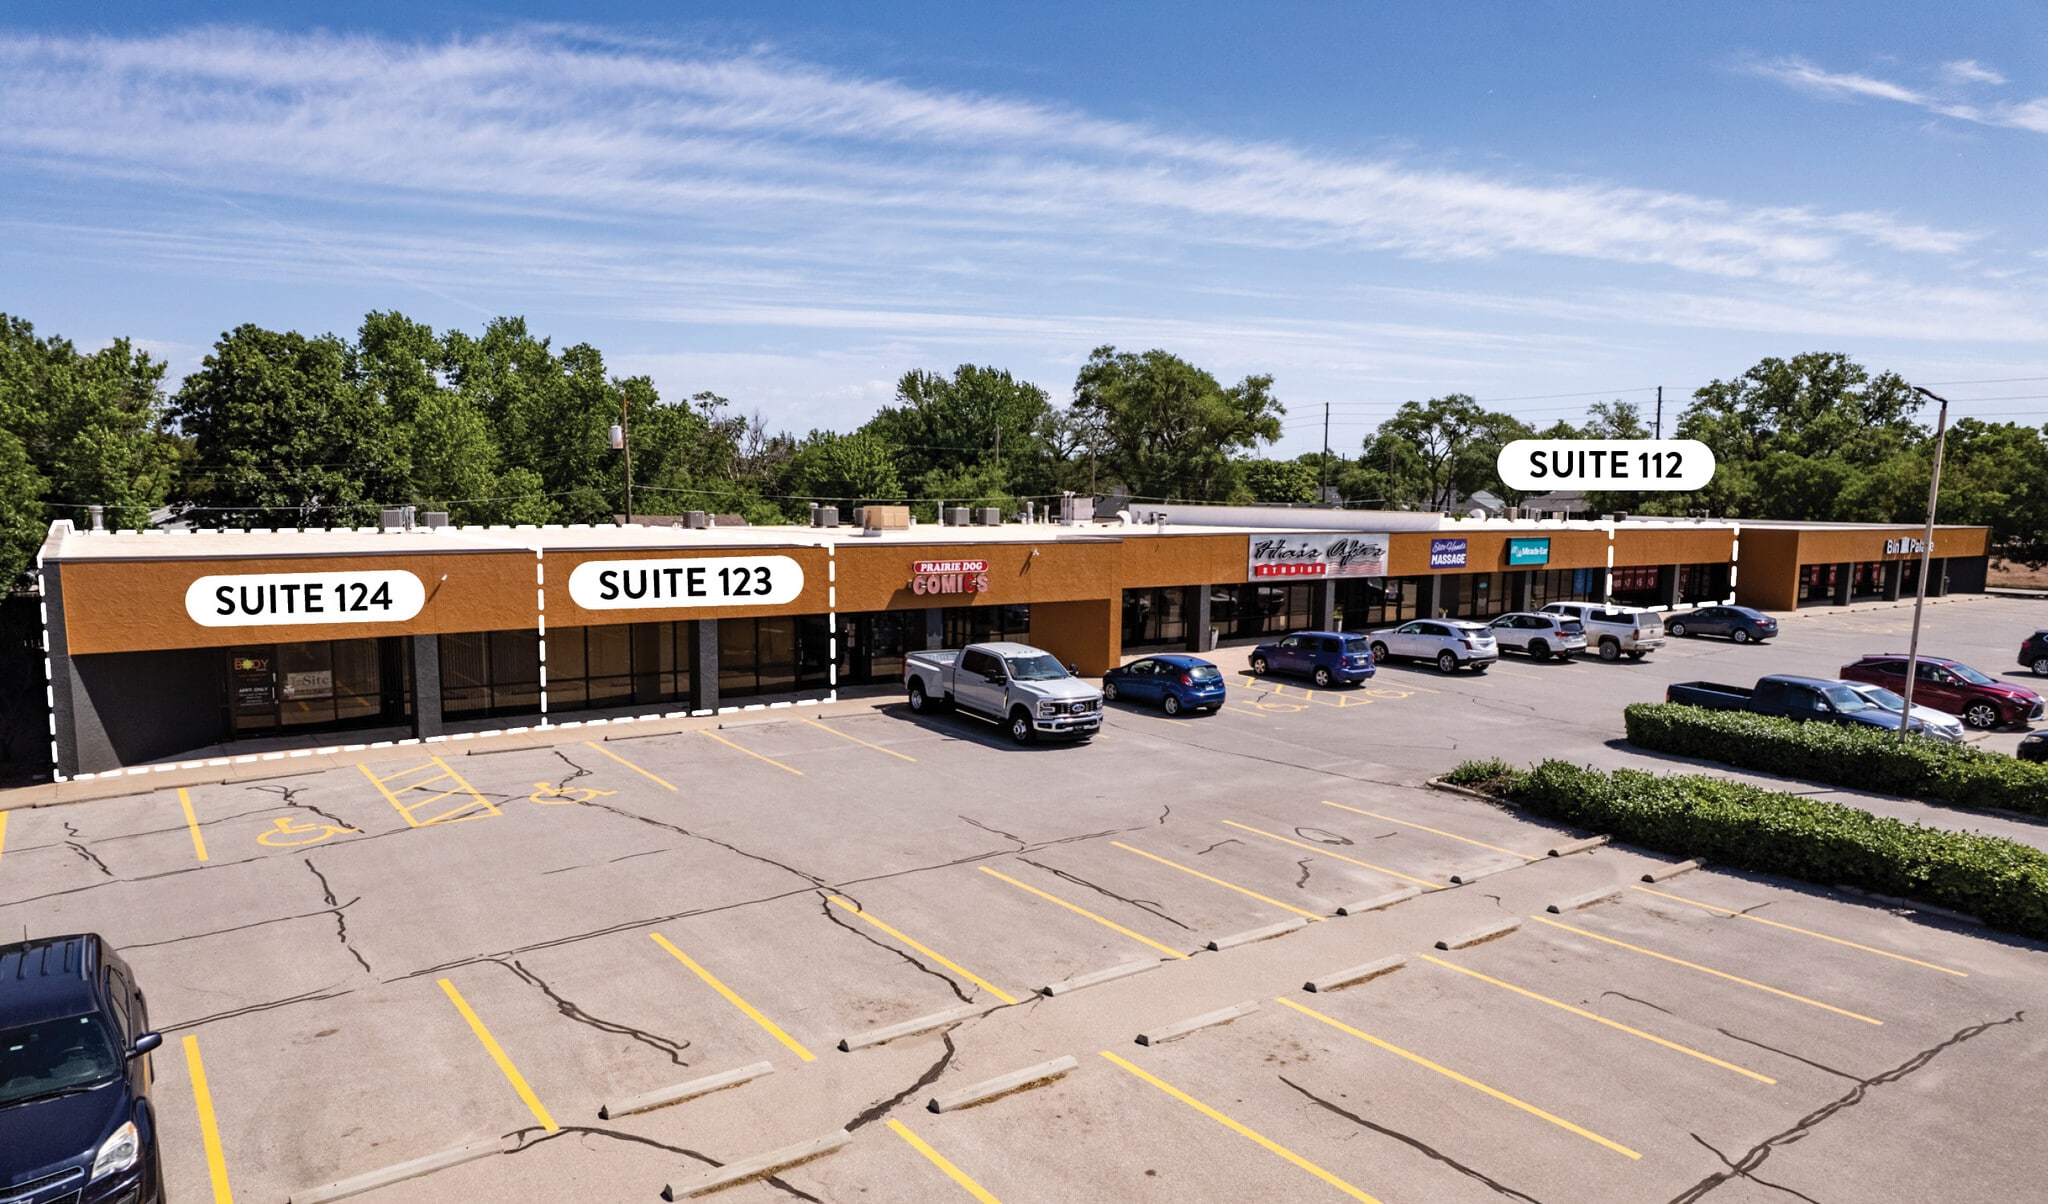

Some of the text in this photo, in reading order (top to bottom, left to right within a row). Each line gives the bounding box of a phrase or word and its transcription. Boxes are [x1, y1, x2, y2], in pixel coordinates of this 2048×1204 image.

[1254, 538, 1386, 568] Hair After
[1886, 538, 1935, 554] Bin Palae
[920, 561, 983, 572] PRAIRIE DOG
[1431, 554, 1466, 566] MASSAGE
[1262, 564, 1322, 575] STUDIOS
[912, 573, 989, 596] COMICS
